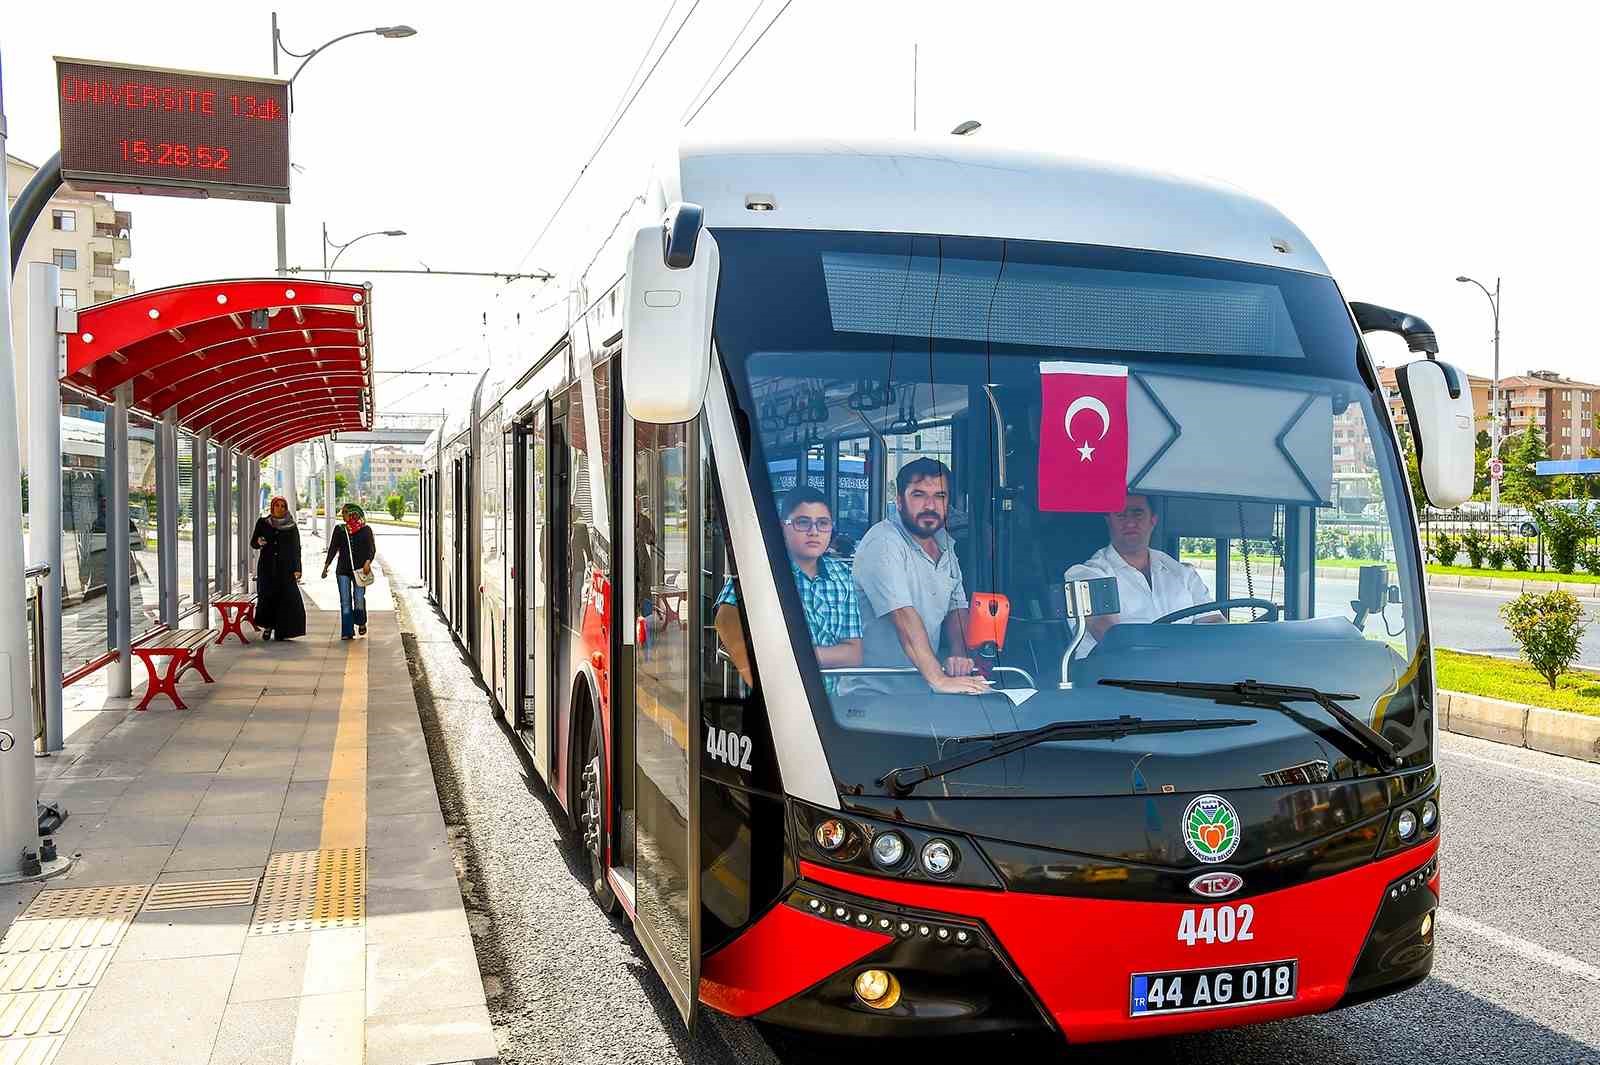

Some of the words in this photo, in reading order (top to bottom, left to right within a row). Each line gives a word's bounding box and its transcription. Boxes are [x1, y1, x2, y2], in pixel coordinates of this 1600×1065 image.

[119, 138, 231, 170] 15:26:52
[706, 726, 752, 772] 4402
[1177, 904, 1255, 946] 4402
[1134, 997, 1146, 1007] TR
[1148, 977, 1182, 1008] 44
[1193, 973, 1232, 1004] AG
[1242, 966, 1290, 999] 018
